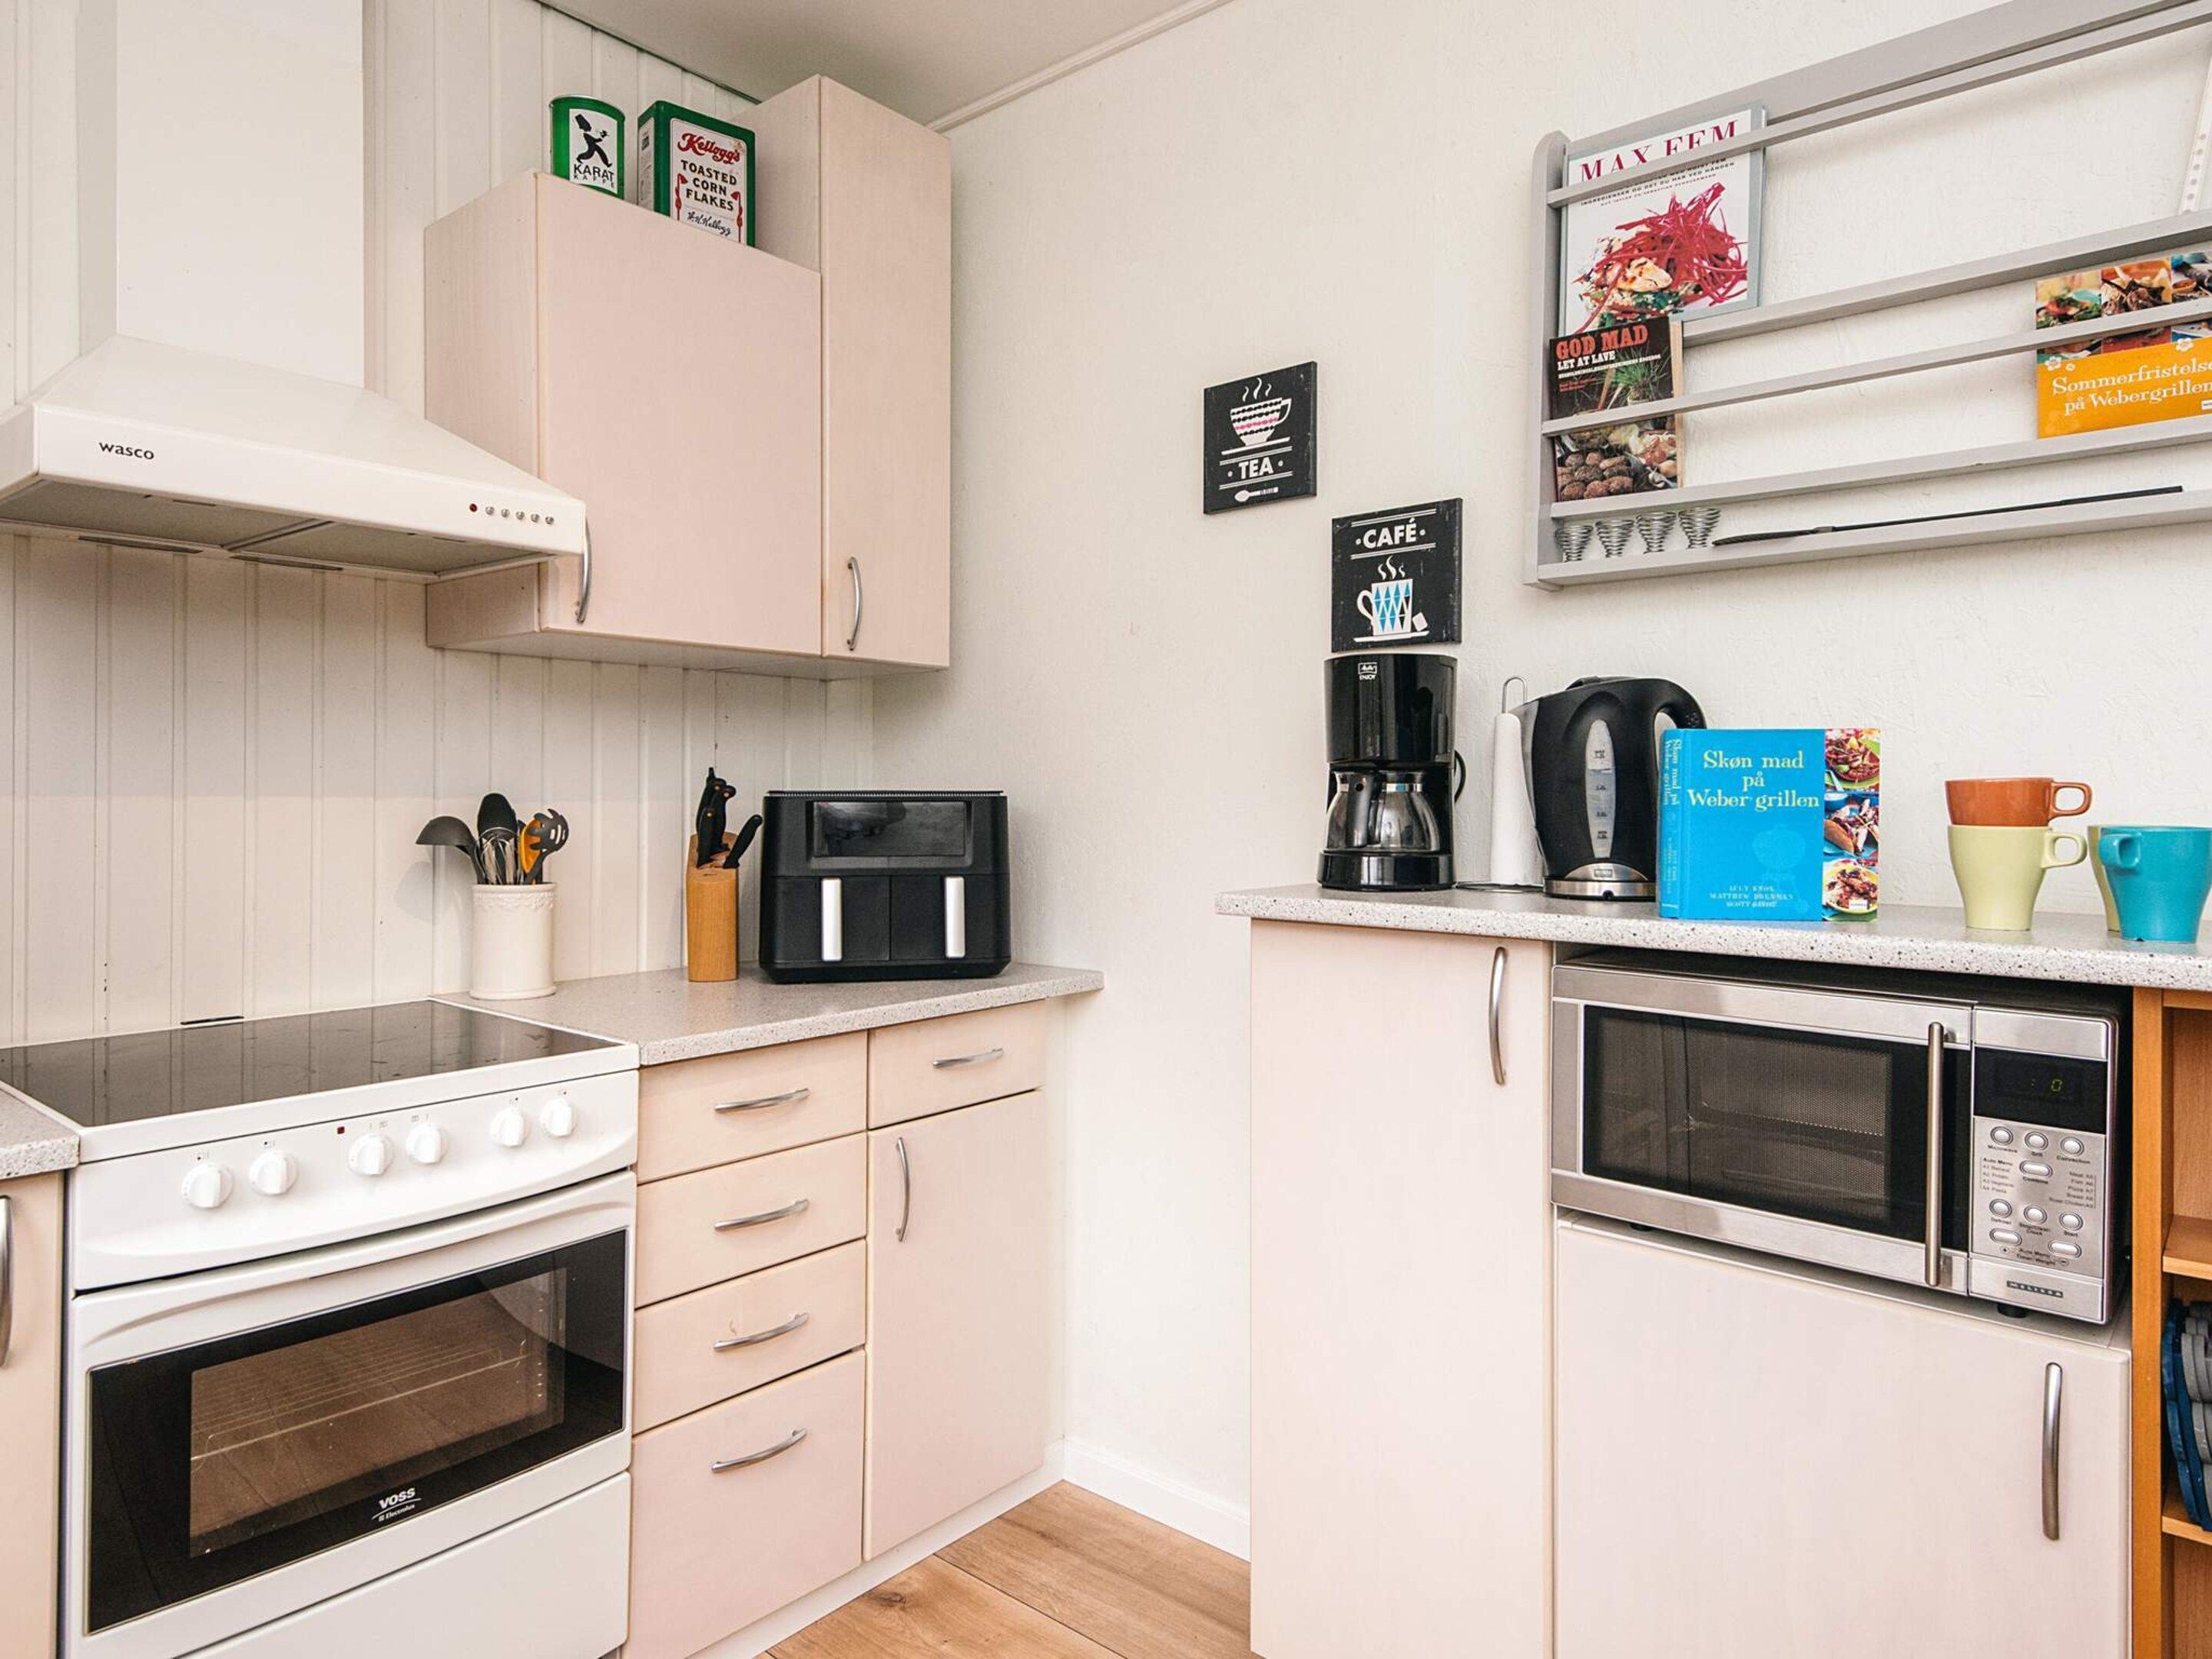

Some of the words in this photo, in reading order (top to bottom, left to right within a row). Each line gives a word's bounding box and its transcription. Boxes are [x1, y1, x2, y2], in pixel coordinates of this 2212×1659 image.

[677, 133, 741, 165] Kellogg's
[574, 164, 614, 182] KARAT
[680, 159, 737, 186] TOASTED
[1581, 145, 1652, 182] MAX
[693, 177, 727, 196] CORN
[686, 188, 734, 211] FLAKES
[1556, 335, 1596, 360] GOD
[1601, 324, 1648, 352] MAD
[1558, 359, 1575, 371] LET
[1577, 356, 1590, 367] AT
[1591, 350, 1616, 364] LAVE
[2065, 397, 2086, 416] på
[98, 442, 154, 460] wasco
[1238, 457, 1274, 479] TEA
[1363, 518, 1417, 549] CAFÉ
[1703, 750, 1753, 769] Skøn
[1762, 750, 1804, 769] mad
[1742, 771, 1765, 793] på
[379, 1488, 416, 1509] VOSS
